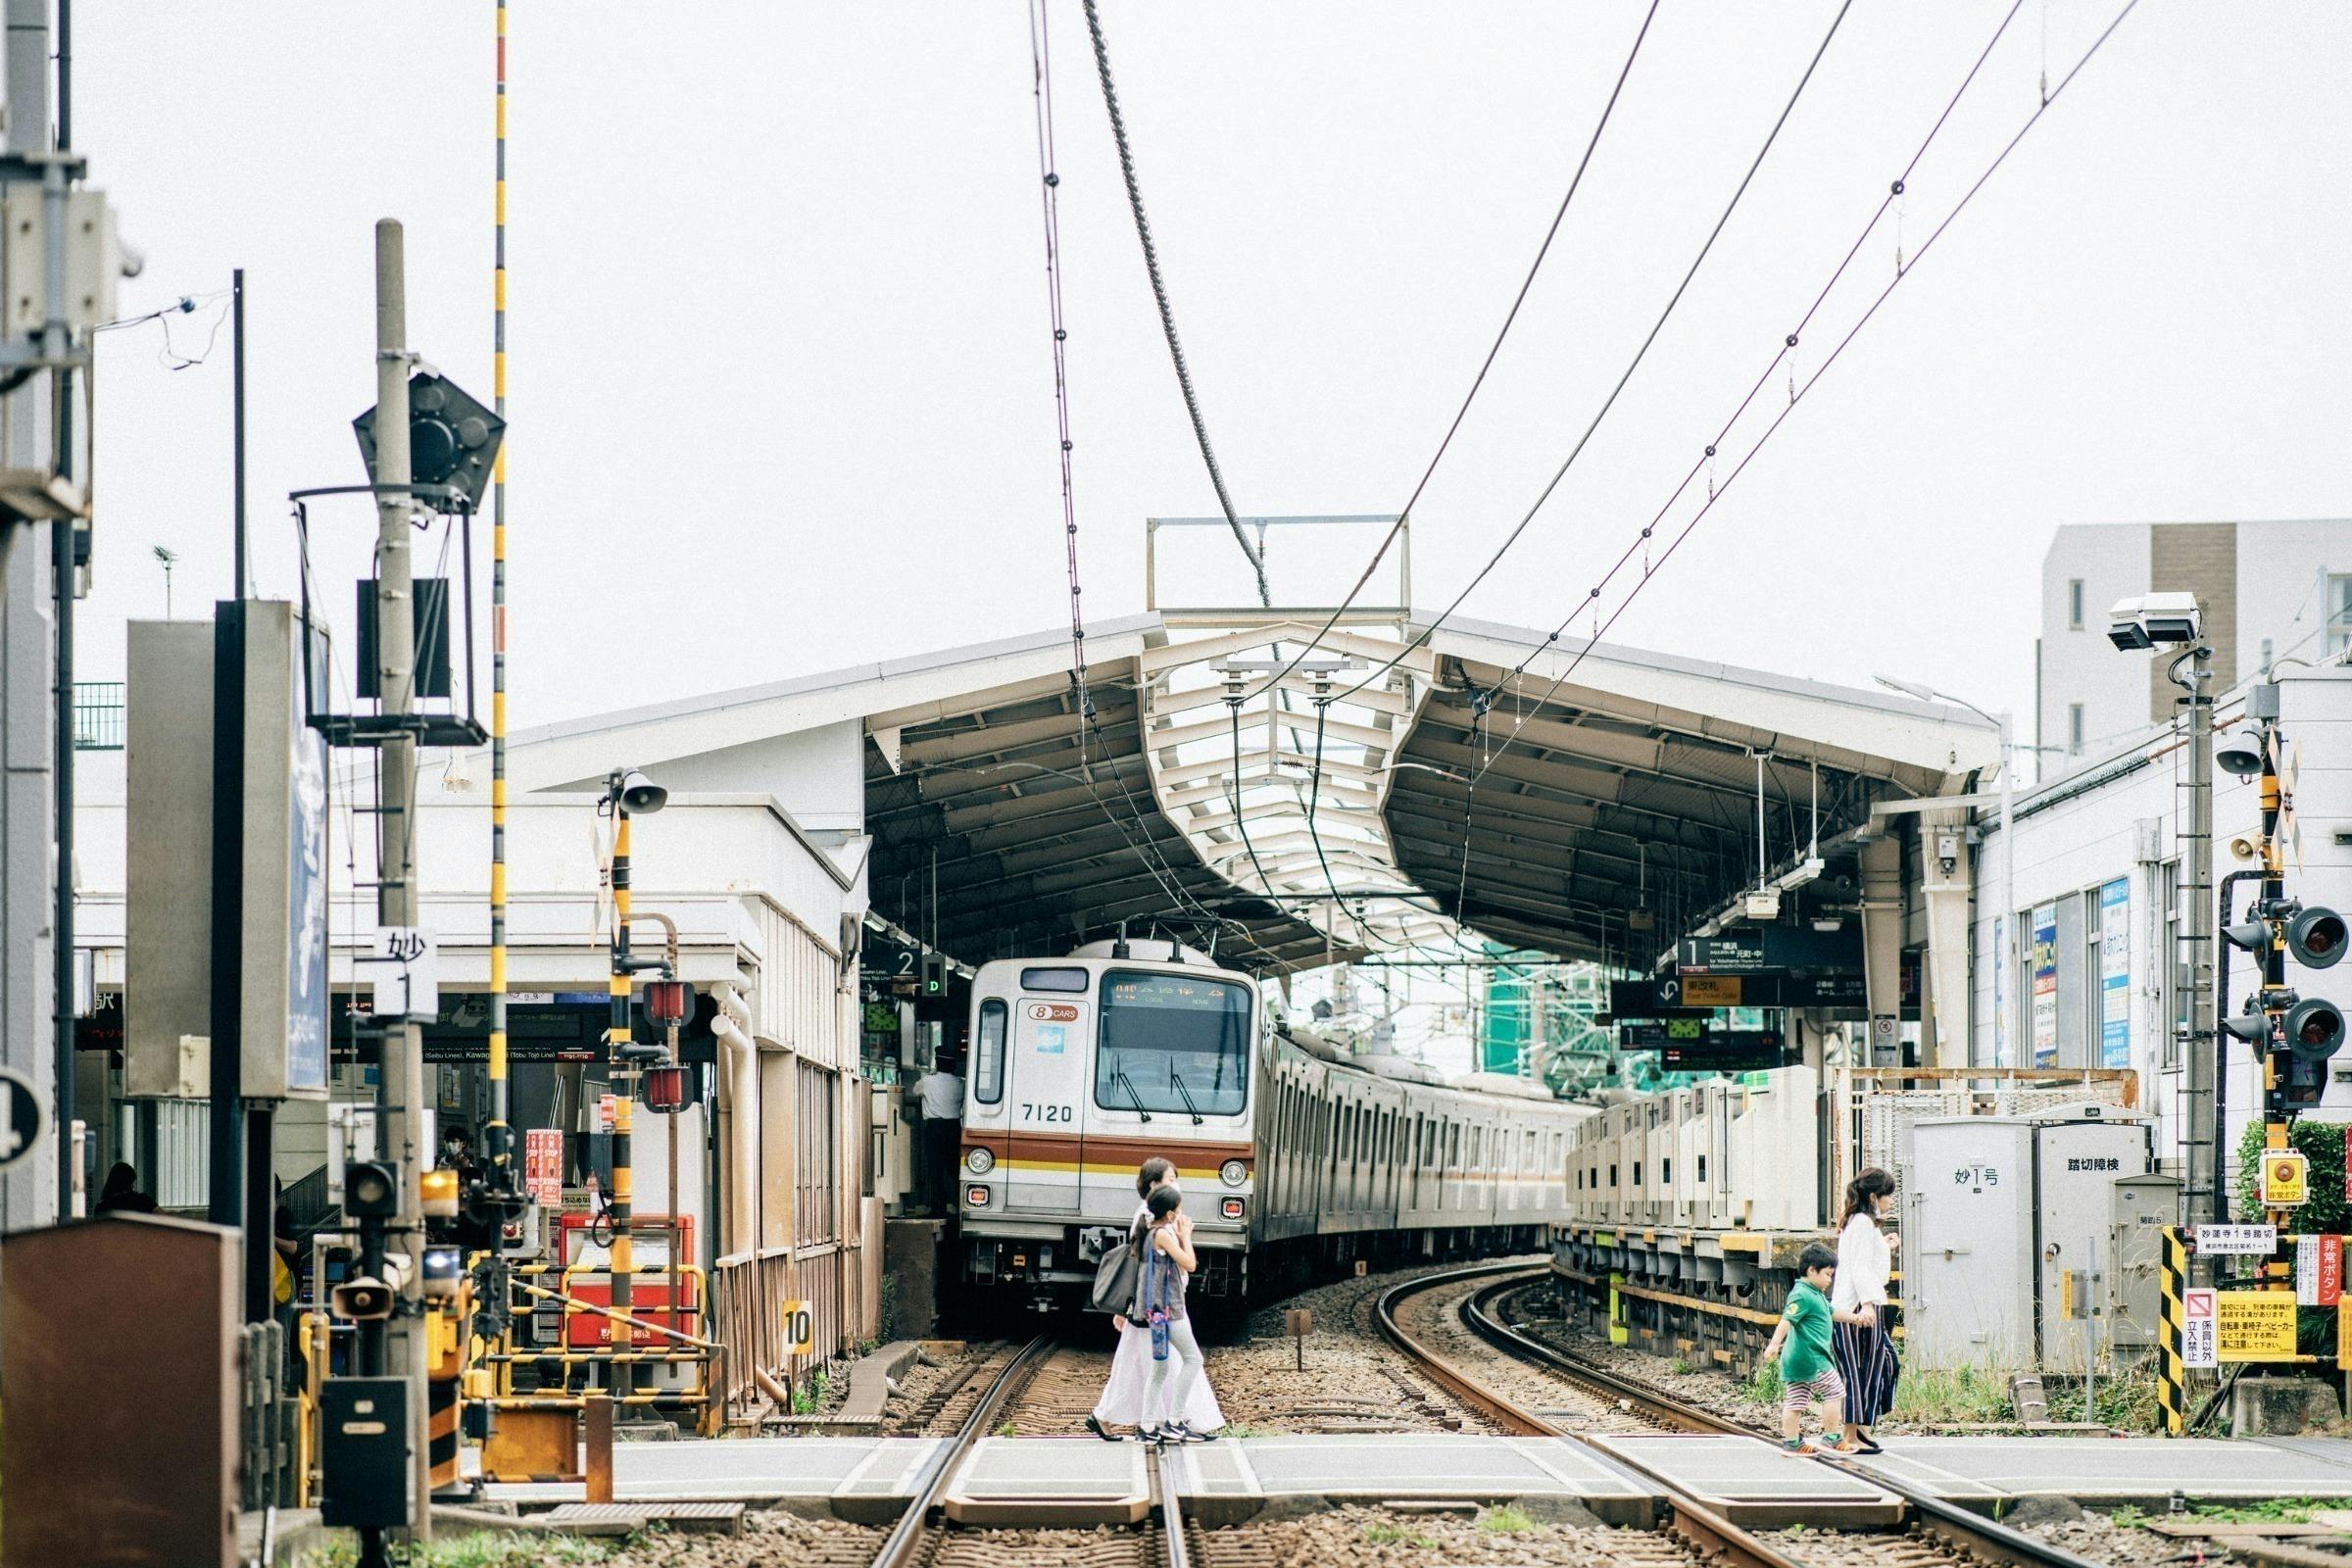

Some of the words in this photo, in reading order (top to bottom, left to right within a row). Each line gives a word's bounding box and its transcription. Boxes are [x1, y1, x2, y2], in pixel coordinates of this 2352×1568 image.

[899, 952, 913, 975] 2
[1688, 940, 1696, 965] 1
[929, 981, 939, 991] D
[1035, 1006, 1046, 1018] 8
[1053, 1009, 1076, 1019] CARS
[1022, 1103, 1072, 1122] 7120
[2068, 1158, 2119, 1171] 踏切障検
[1954, 1168, 1998, 1186] 妙1号
[2323, 1238, 2337, 1301] 非常ボタン
[785, 1310, 810, 1345] 10
[2187, 1321, 2197, 1362] 立入禁止
[2202, 1320, 2212, 1361] 係員以外
